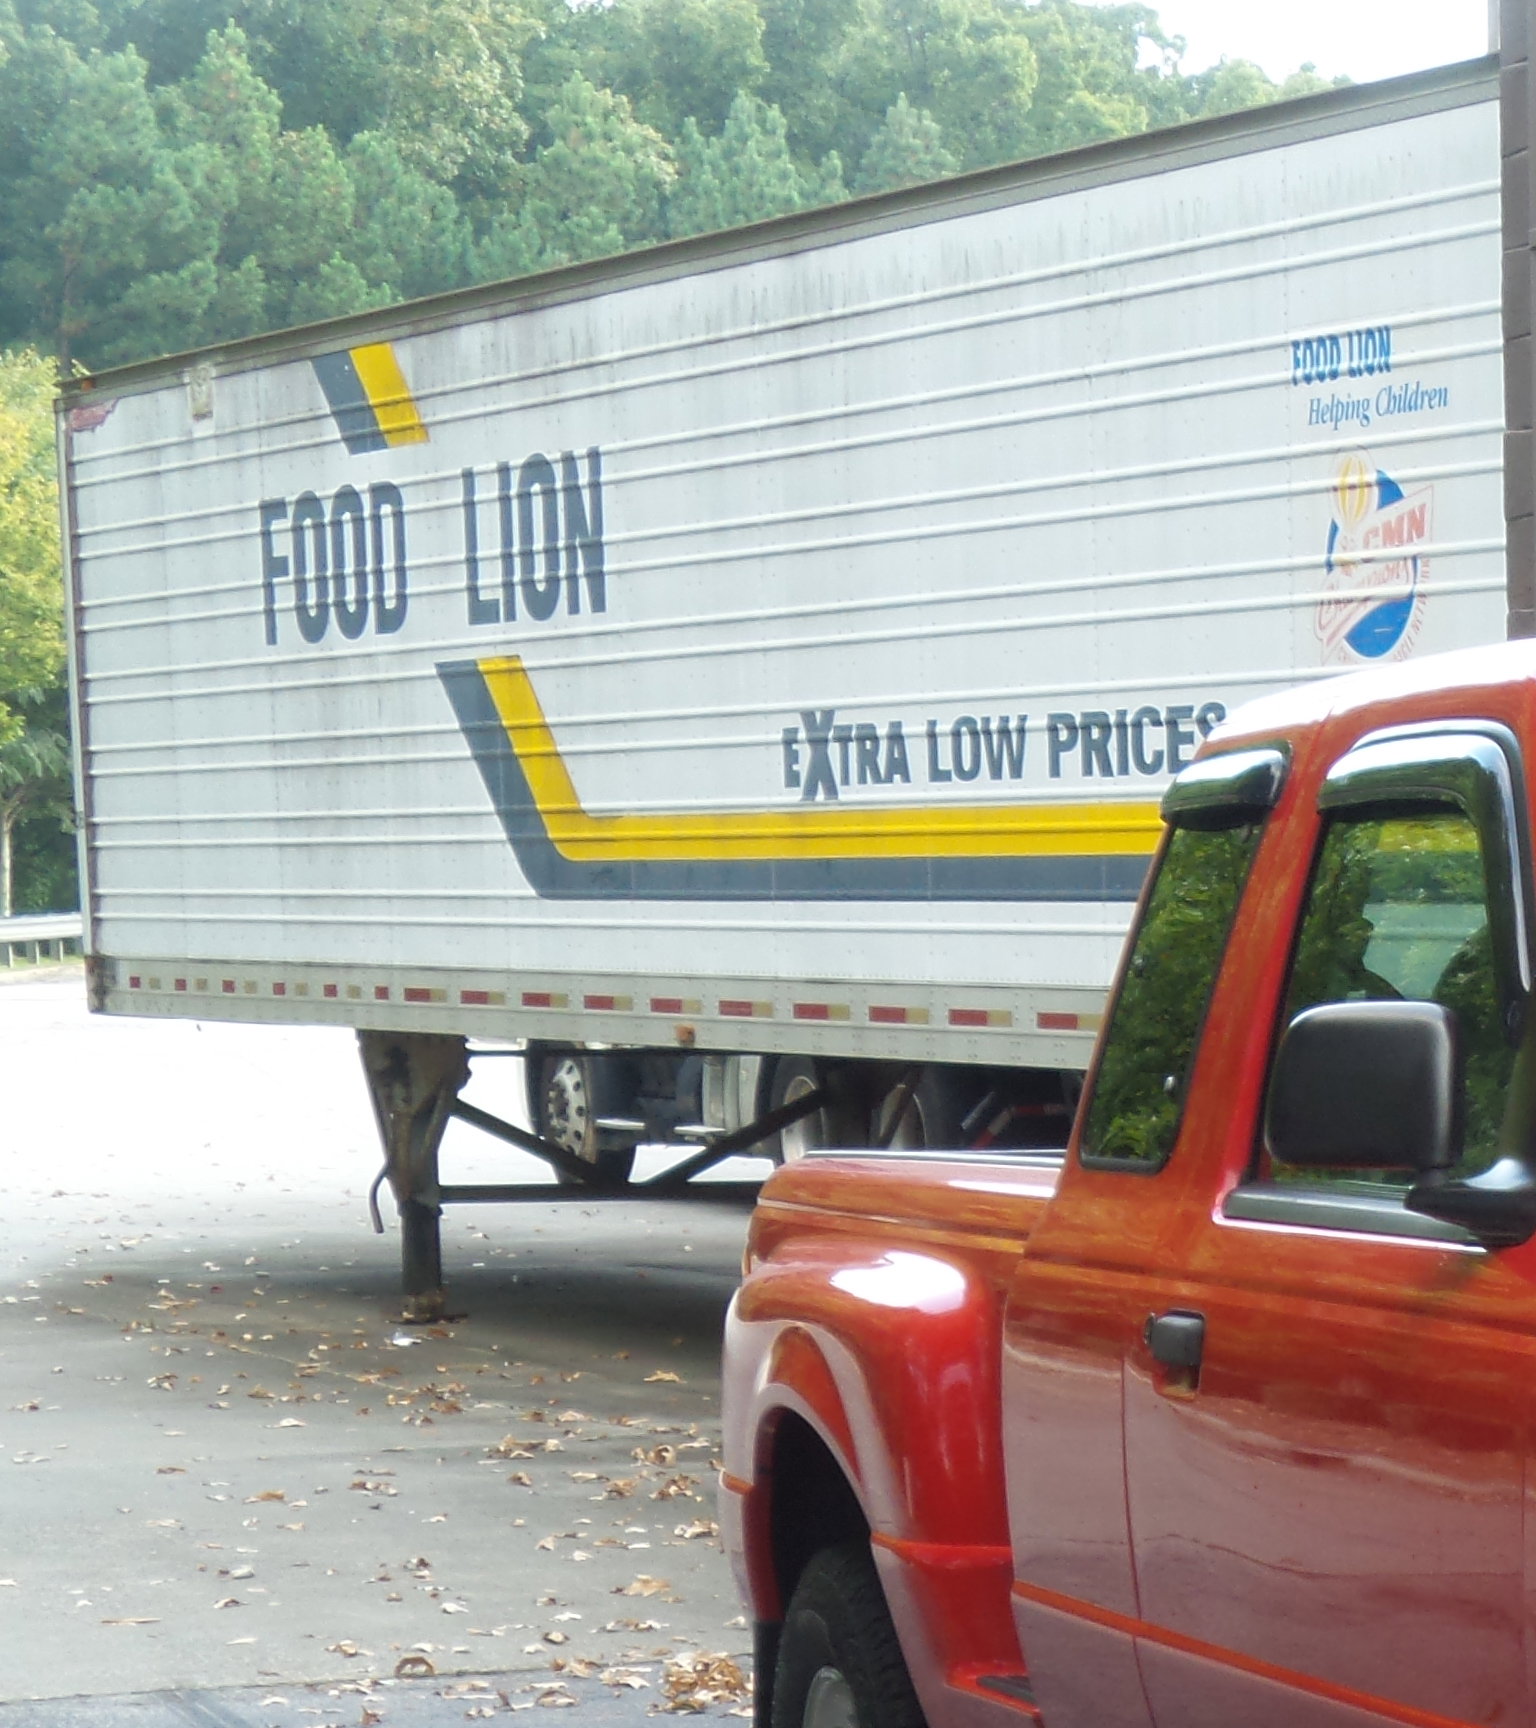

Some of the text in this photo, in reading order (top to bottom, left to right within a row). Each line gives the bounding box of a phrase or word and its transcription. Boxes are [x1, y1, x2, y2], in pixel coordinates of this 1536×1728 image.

[1290, 325, 1392, 386] FOOD LION
[1308, 381, 1448, 430] Helping Children
[258, 446, 607, 645] FOOD LION
[926, 713, 1028, 783] LOW
